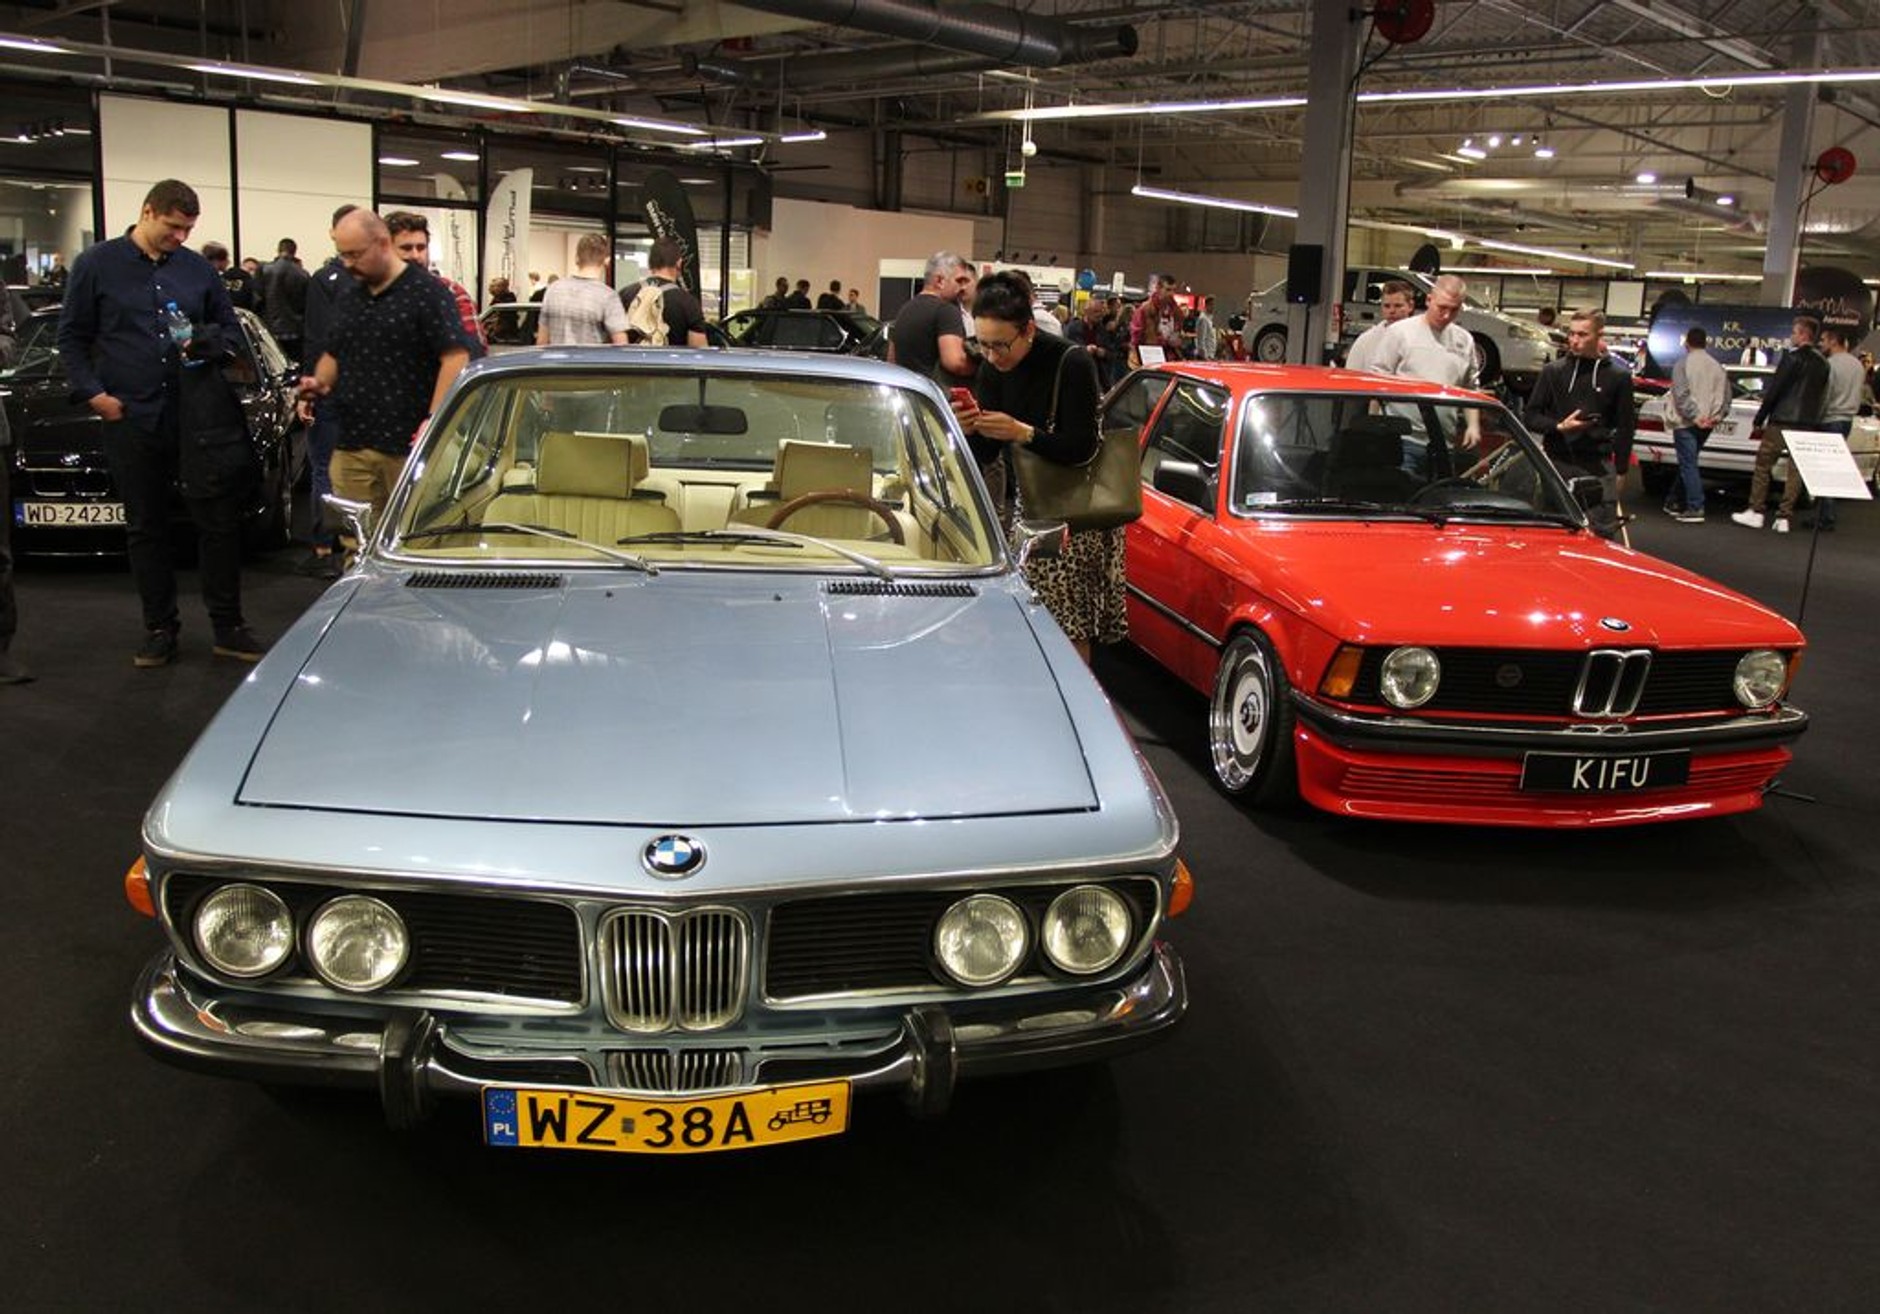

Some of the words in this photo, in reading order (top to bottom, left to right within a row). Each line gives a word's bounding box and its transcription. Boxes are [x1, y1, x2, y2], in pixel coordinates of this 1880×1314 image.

[27, 505, 57, 522] WD
[1572, 757, 1650, 790] KIFU
[493, 1123, 516, 1136] PL
[528, 1096, 617, 1146] WZ
[643, 1101, 755, 1148] 38A
